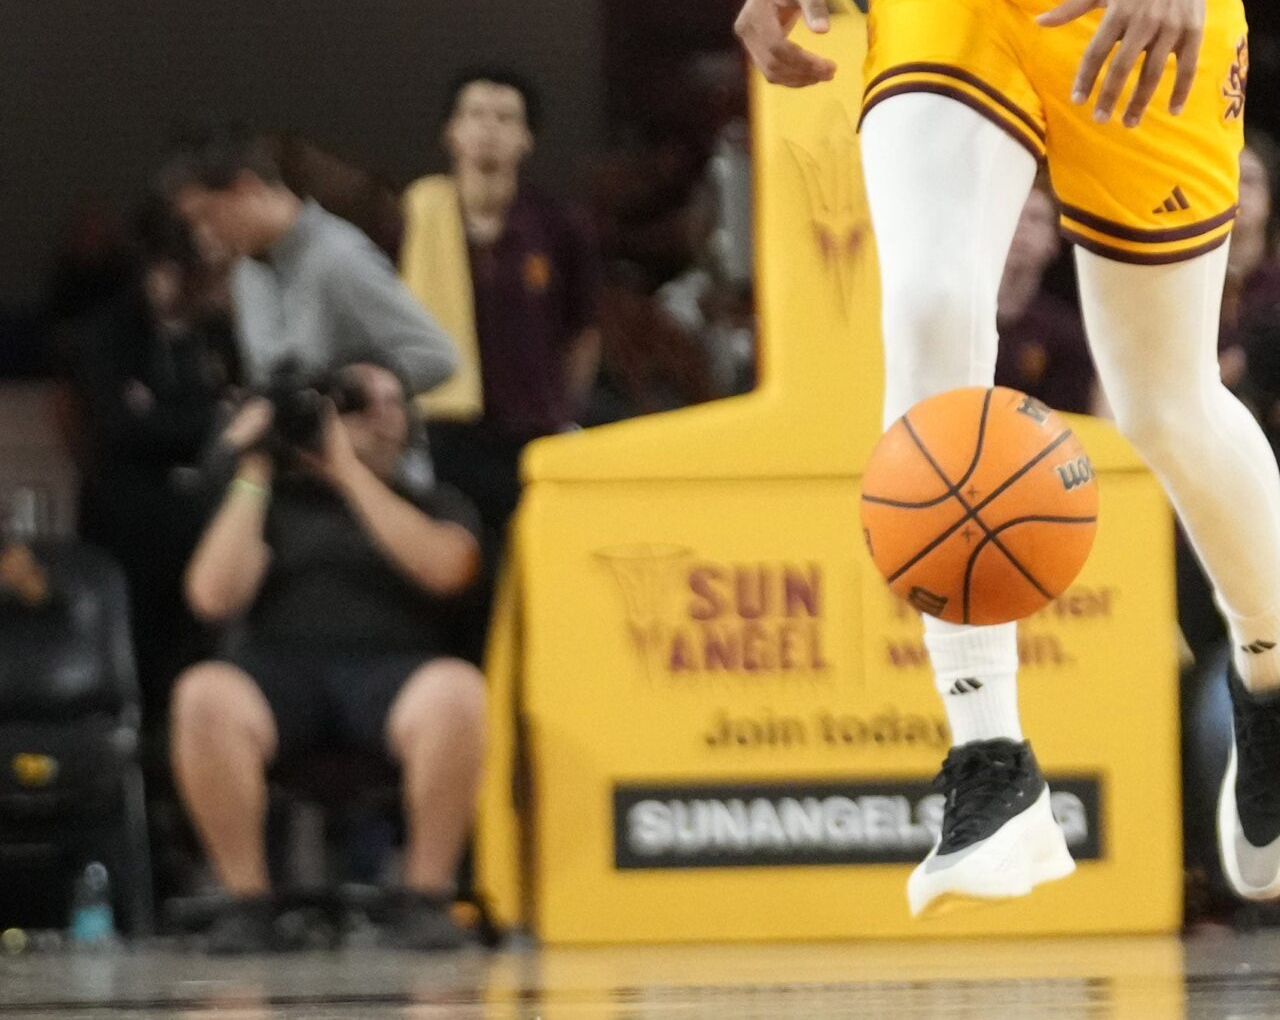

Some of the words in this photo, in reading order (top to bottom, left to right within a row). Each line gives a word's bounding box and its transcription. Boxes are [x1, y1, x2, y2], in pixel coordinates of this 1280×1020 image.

[687, 560, 822, 621] SUN
[666, 625, 830, 674] ANGEL
[704, 707, 805, 750] Join
